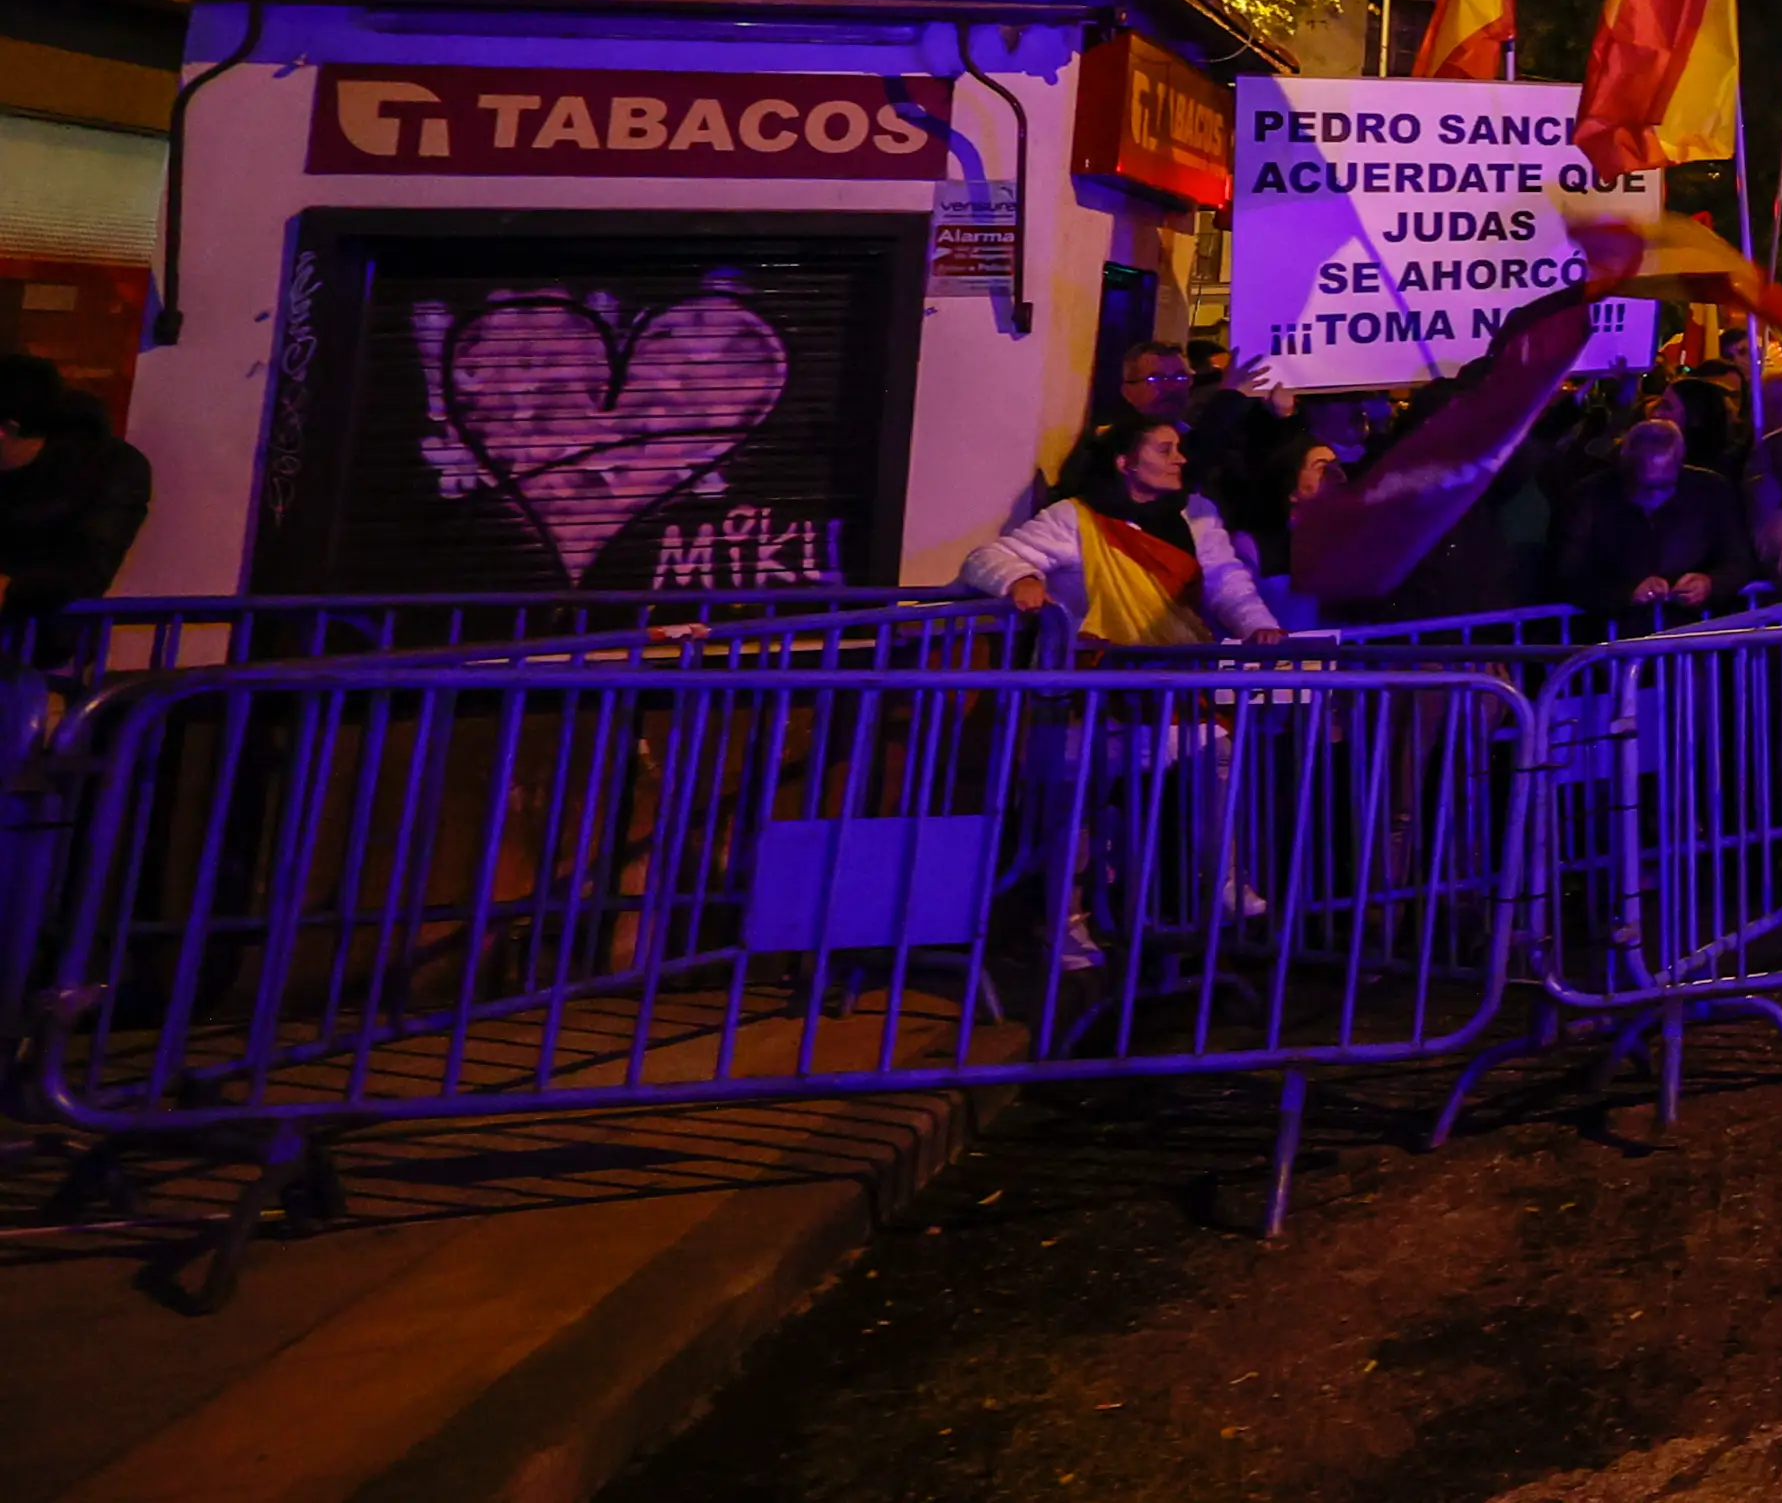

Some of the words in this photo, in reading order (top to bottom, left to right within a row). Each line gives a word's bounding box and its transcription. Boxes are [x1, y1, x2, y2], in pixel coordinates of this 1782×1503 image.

[476, 93, 930, 155] TABACOS
[1253, 110, 1421, 145] PEDRO
[1251, 161, 1543, 195] ACUERDATE
[936, 227, 1016, 244] Alarma
[1382, 210, 1537, 244] JUDAS
[1318, 261, 1381, 295] SE
[1396, 249, 1588, 293] AHORCÓ
